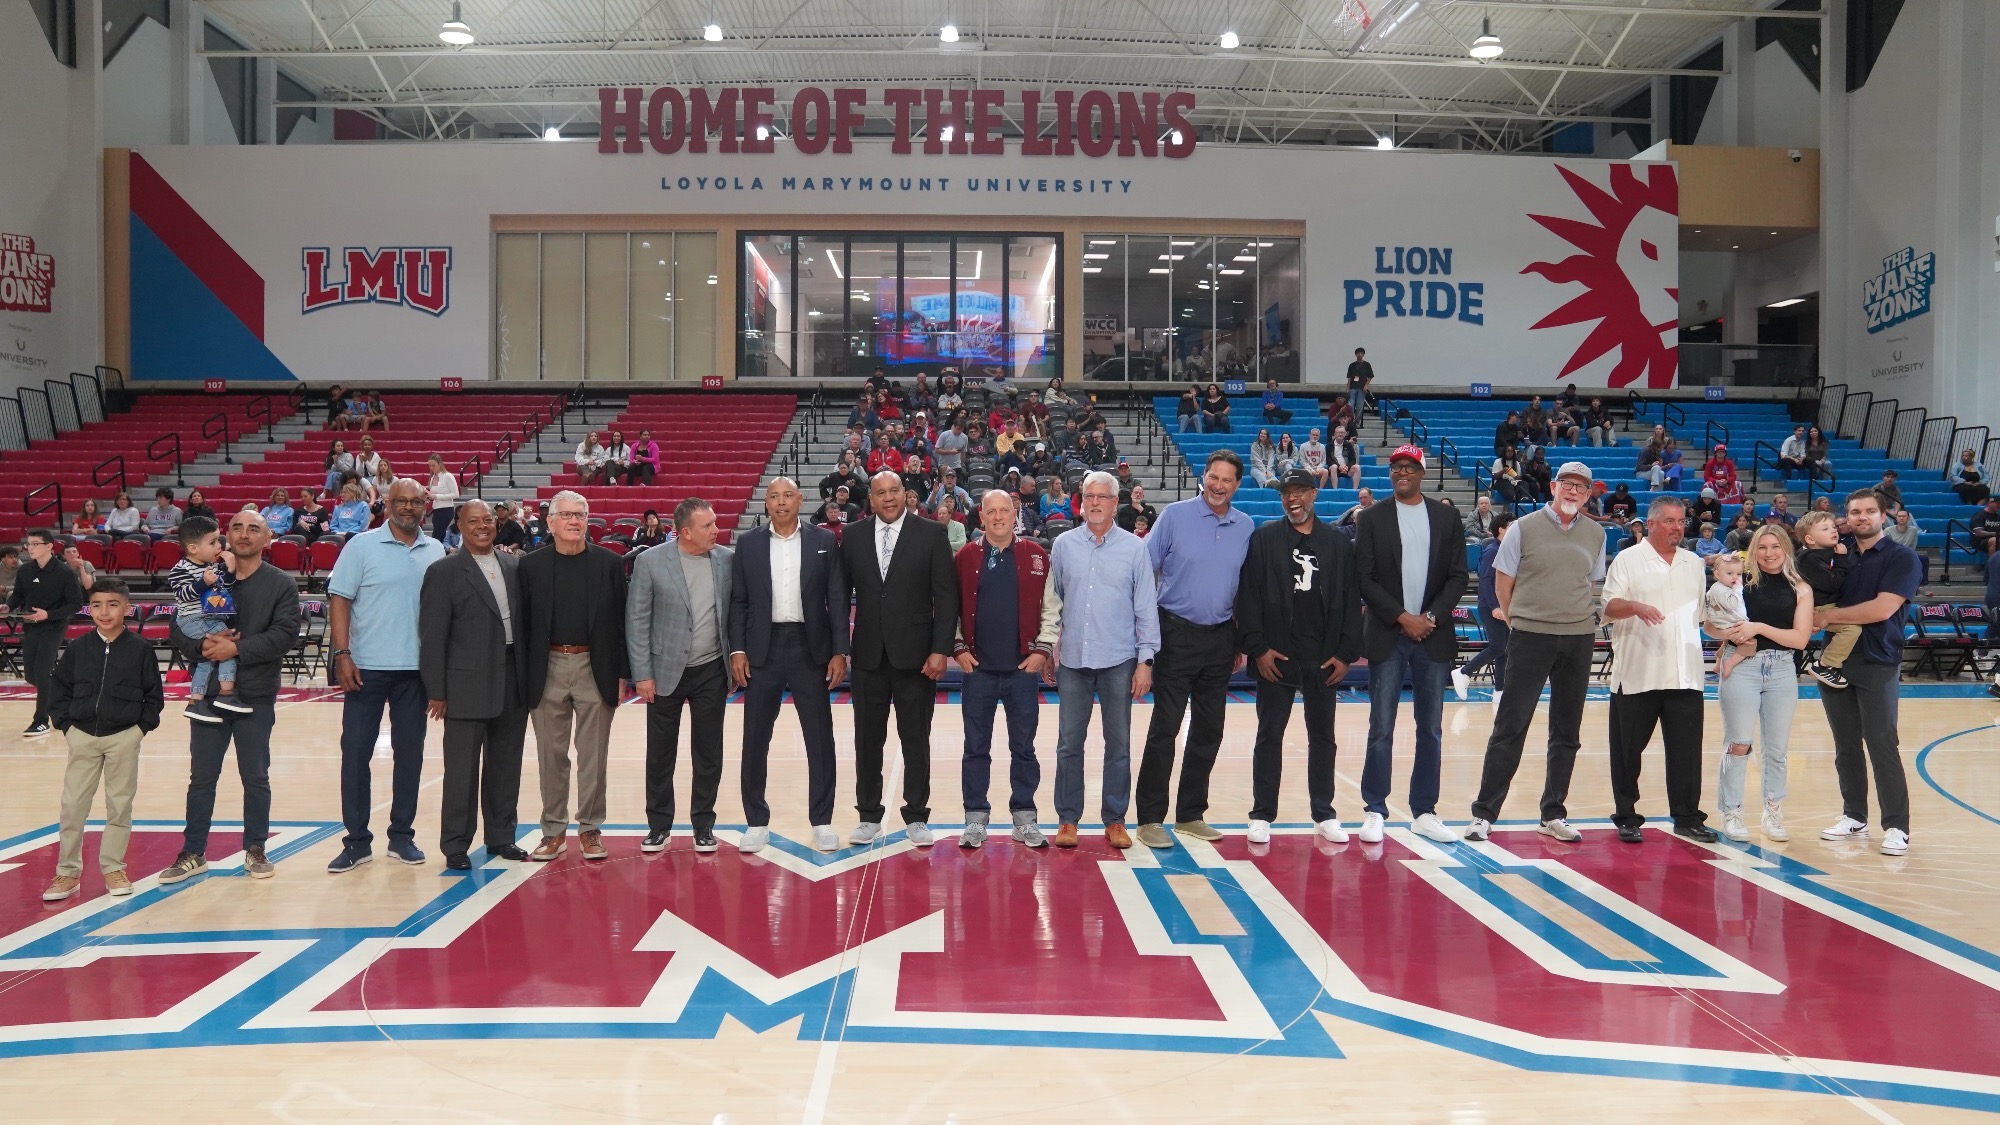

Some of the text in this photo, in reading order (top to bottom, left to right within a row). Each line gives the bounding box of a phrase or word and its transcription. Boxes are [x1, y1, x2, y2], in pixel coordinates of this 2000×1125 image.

[598, 86, 1197, 158] HOME OF THE LIONS
[661, 176, 1133, 193] LOYOLA MARYMOUNT UNIVERSITY
[2, 233, 34, 252] THE
[0, 249, 53, 281] ANE
[1375, 246, 1453, 275] LION
[1883, 247, 1911, 272] THE
[302, 247, 452, 317] LMU
[1864, 252, 1934, 307] MANE
[0, 277, 49, 308] ONE
[1343, 279, 1484, 326] PRIDE
[1867, 283, 1928, 330] ZONE
[1084, 319, 1115, 331] WCC
[0, 352, 48, 368] NIVERSITY
[1871, 361, 1925, 378] UNIVERSITY
[207, 381, 223, 389] 107
[443, 380, 460, 388] 106
[704, 378, 721, 387] 105
[1227, 382, 1243, 391] 103
[1473, 386, 1489, 394] 102
[1452, 608, 1469, 618] MU
[1920, 605, 1946, 617] LMU
[1959, 607, 1983, 618] LMU
